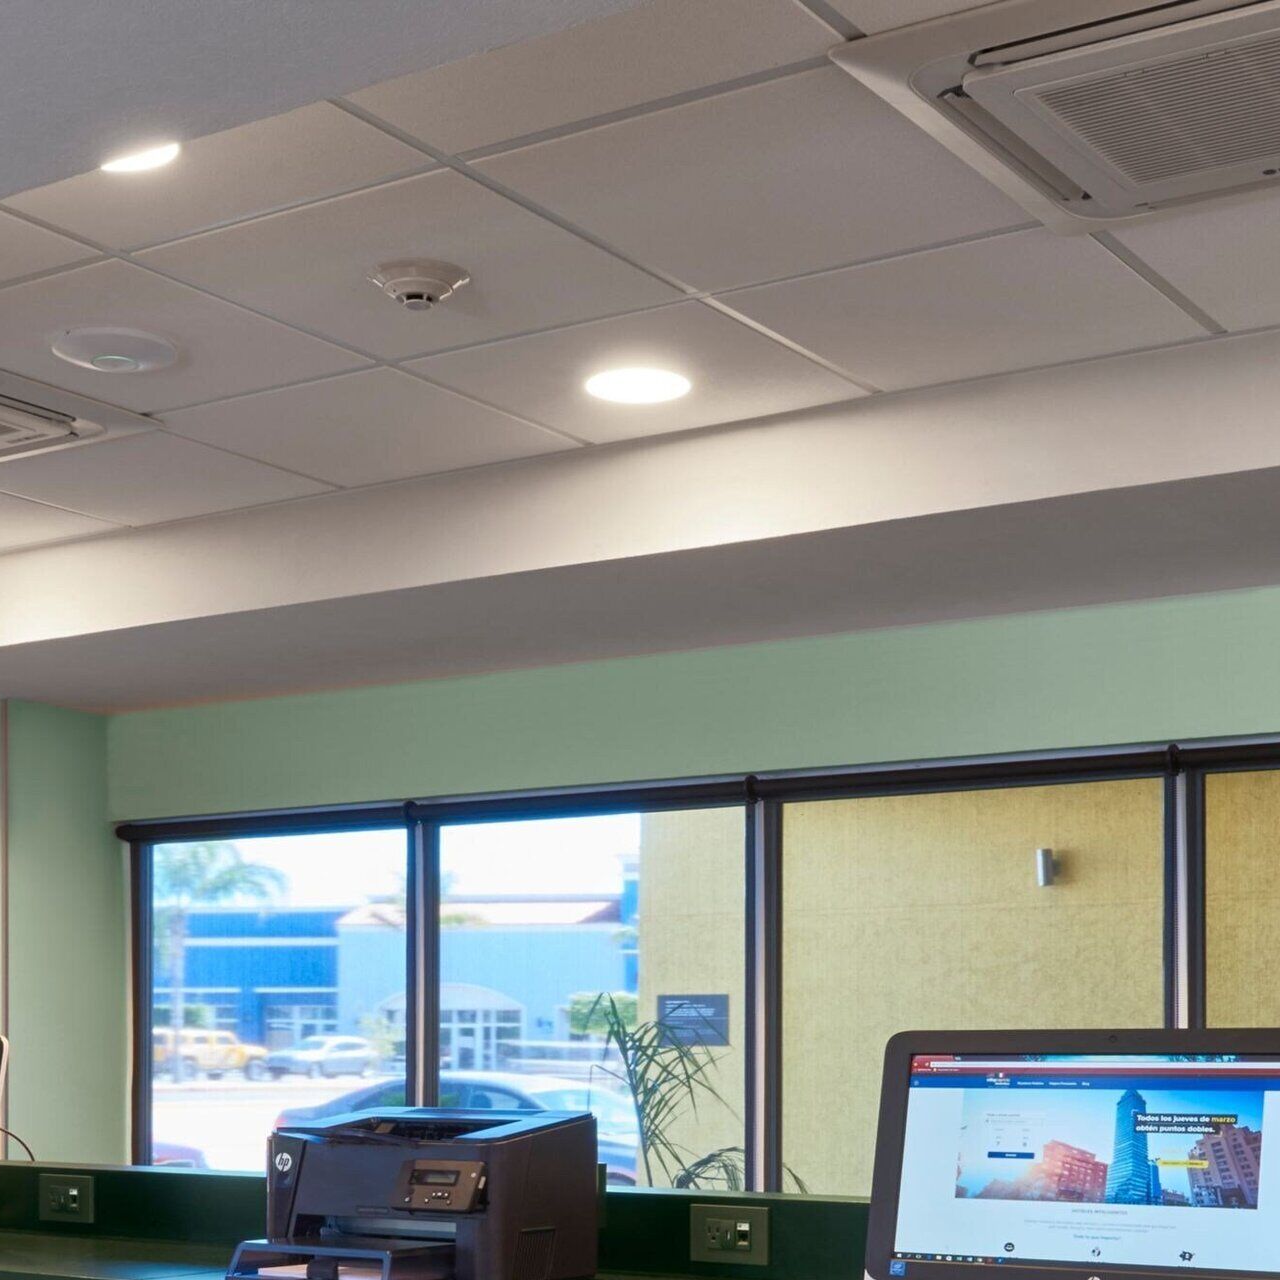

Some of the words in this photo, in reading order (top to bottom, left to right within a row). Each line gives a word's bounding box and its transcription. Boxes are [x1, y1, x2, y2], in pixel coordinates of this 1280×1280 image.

[1136, 1114, 1160, 1122] Todos
[1172, 1115, 1198, 1123] jueves
[276, 1153, 291, 1172] hp
